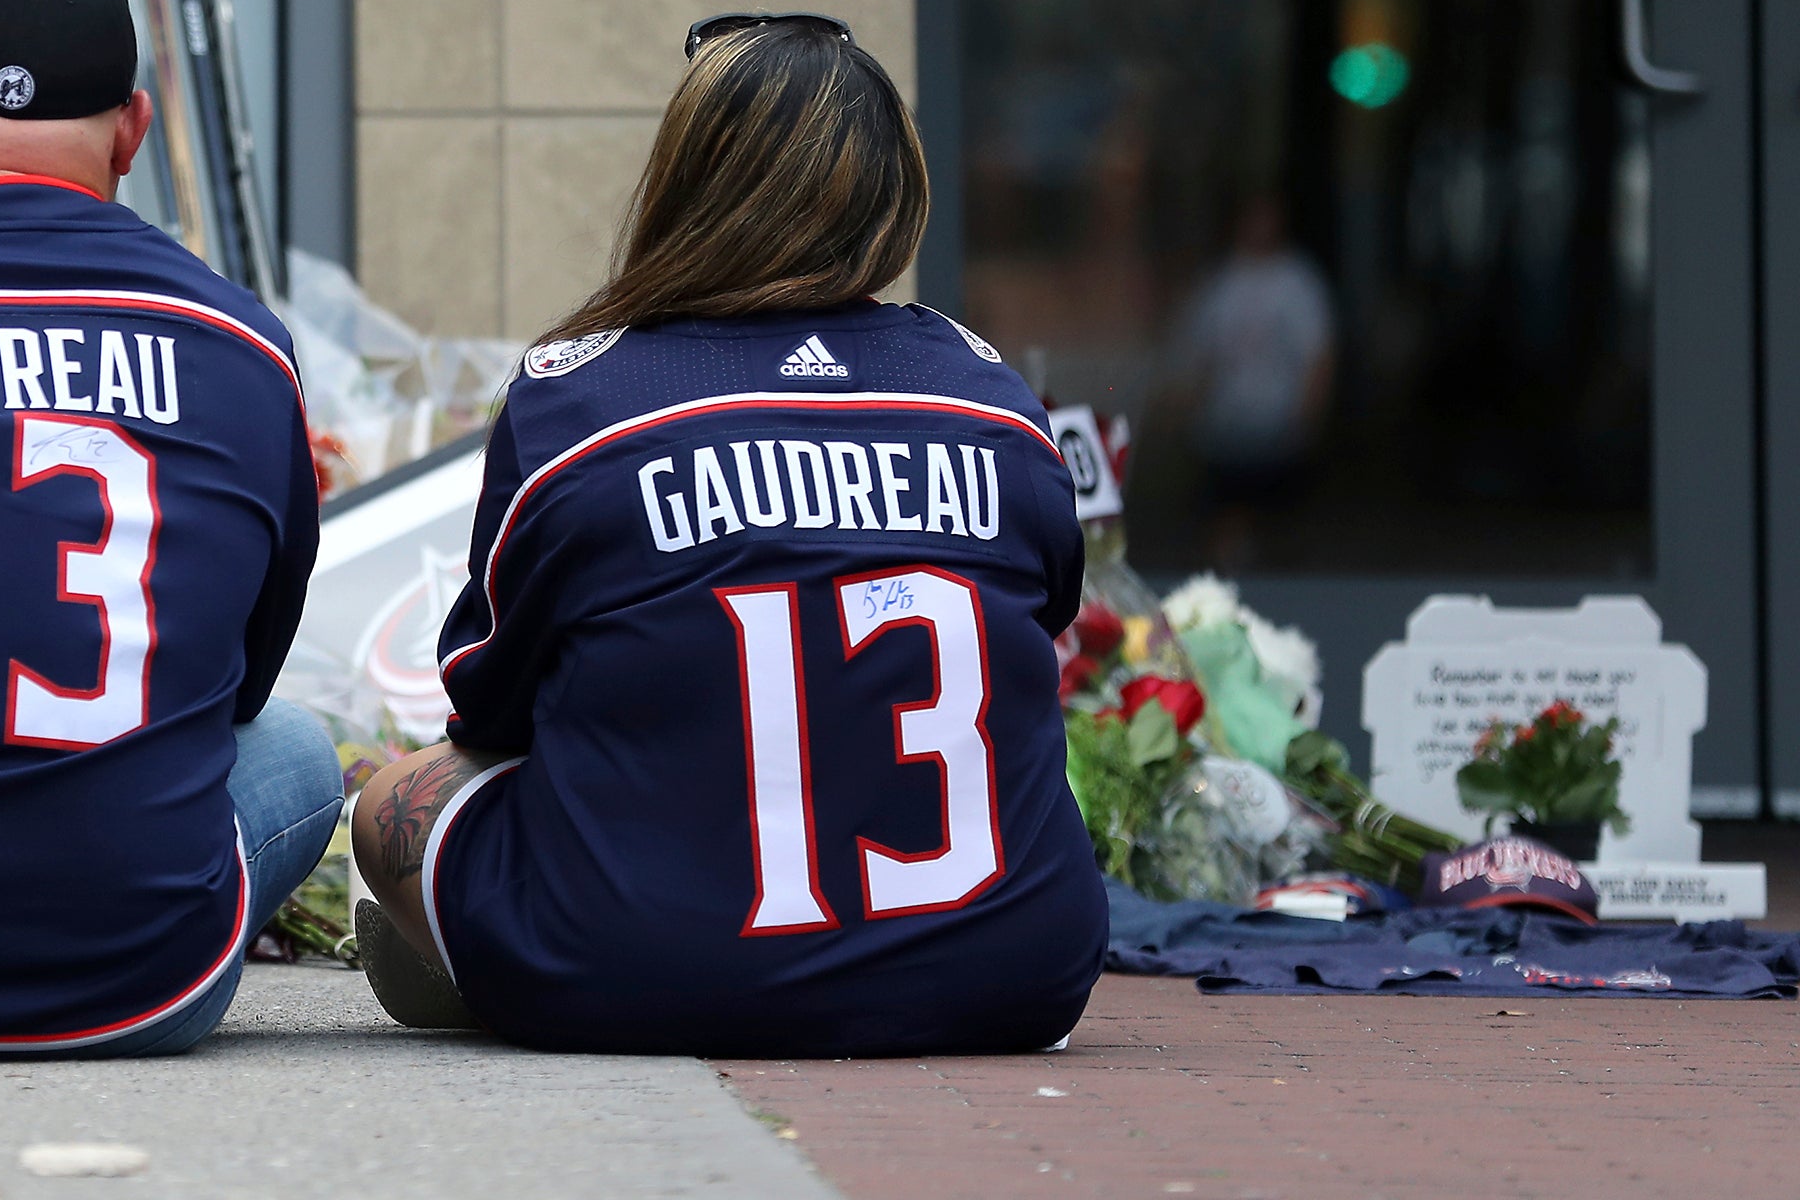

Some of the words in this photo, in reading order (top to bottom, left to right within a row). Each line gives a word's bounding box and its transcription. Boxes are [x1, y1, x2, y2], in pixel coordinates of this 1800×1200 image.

[780, 361, 849, 378] adidas
[637, 439, 1000, 553] GAUDREAU
[711, 563, 1006, 938] 13
